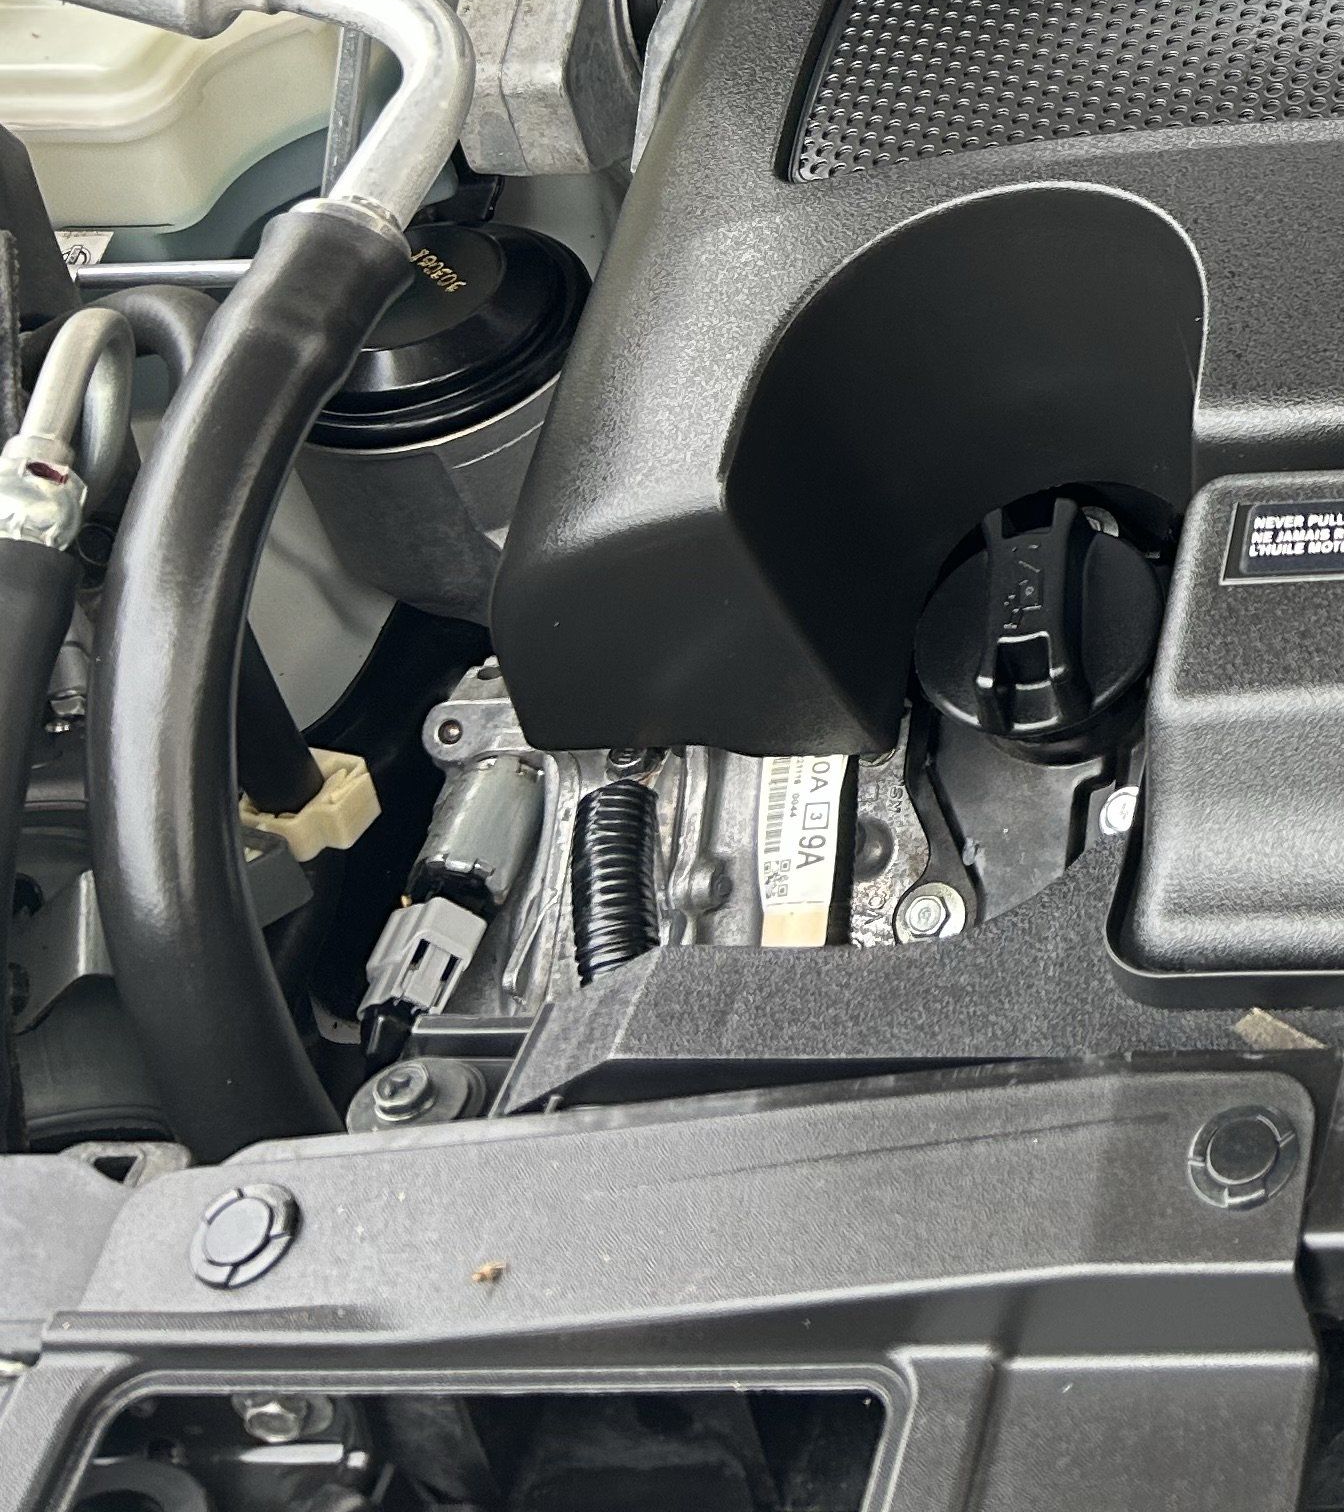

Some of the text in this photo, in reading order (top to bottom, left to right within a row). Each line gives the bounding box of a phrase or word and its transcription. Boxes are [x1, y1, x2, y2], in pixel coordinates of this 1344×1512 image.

[1254, 514, 1304, 529] NEVER
[1307, 513, 1344, 528] PULL
[1251, 530, 1274, 544] NE
[1276, 528, 1330, 543] JAMAIS
[1249, 542, 1305, 557] L'HUILE
[796, 836, 827, 869] 9A
